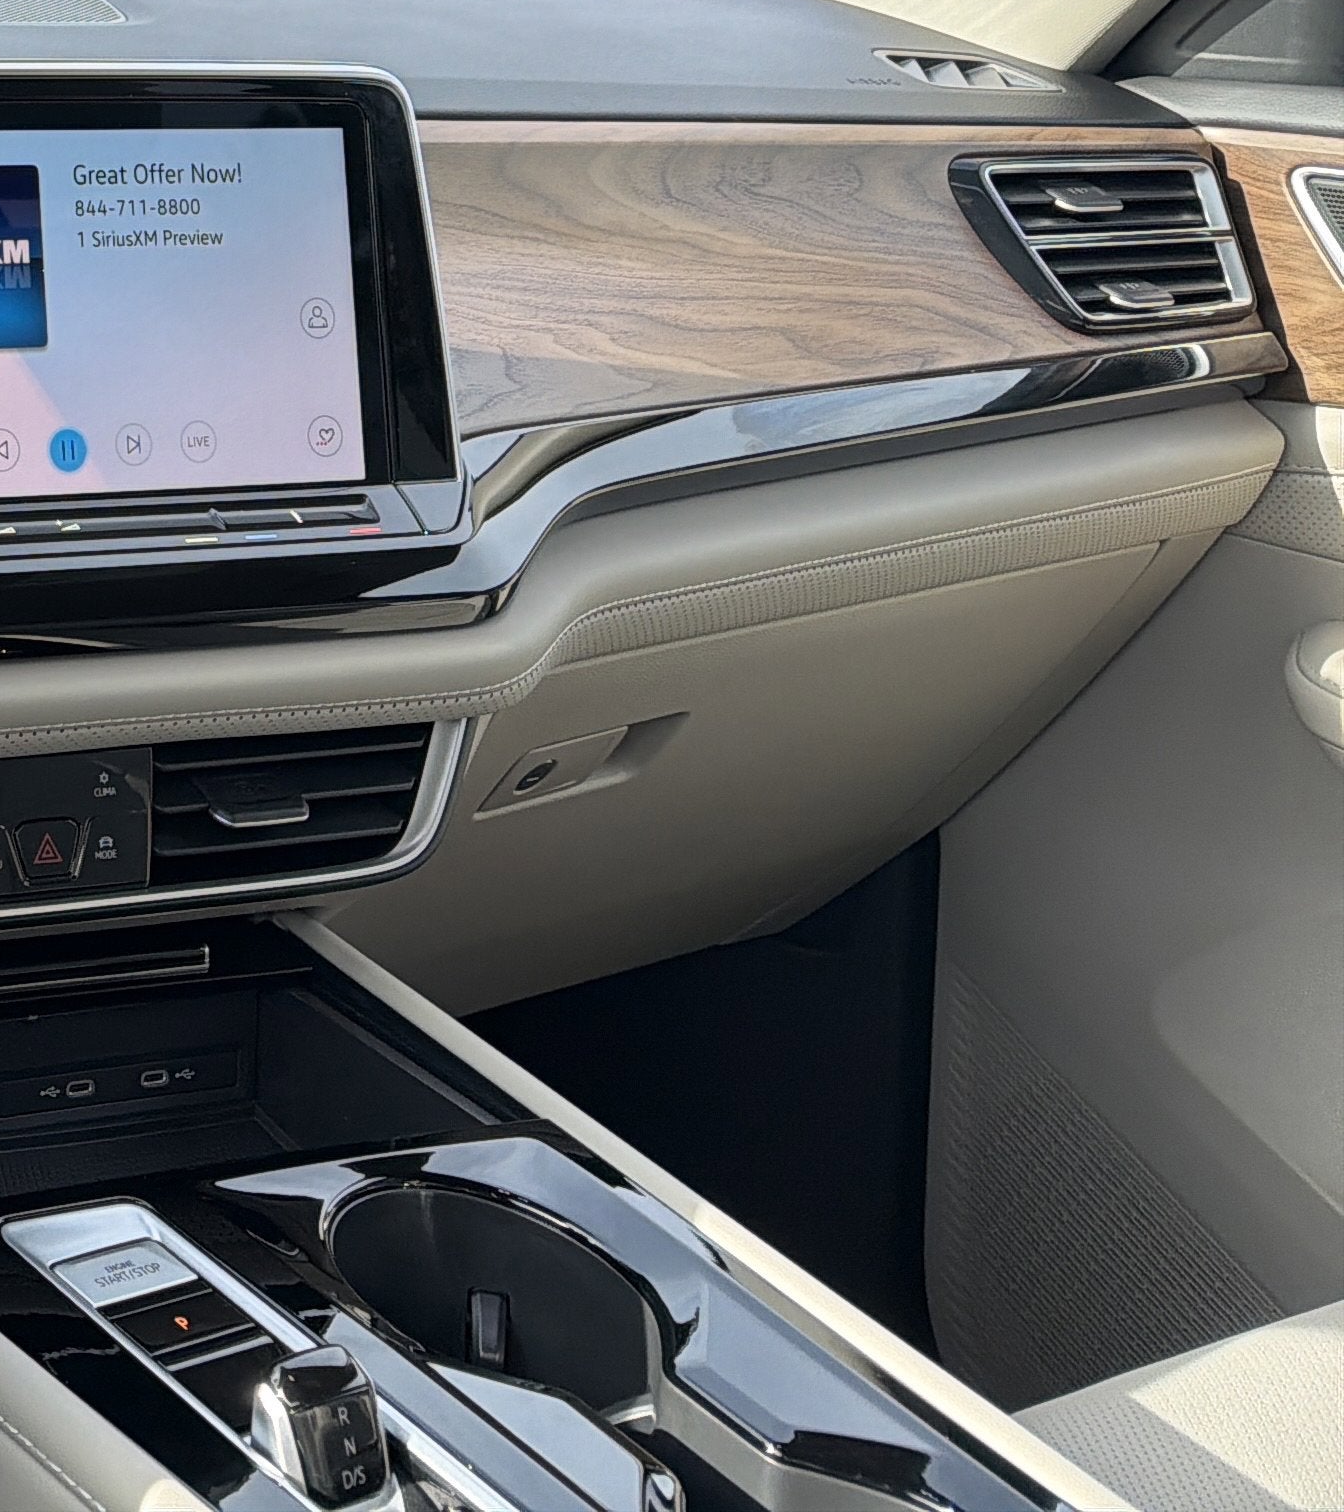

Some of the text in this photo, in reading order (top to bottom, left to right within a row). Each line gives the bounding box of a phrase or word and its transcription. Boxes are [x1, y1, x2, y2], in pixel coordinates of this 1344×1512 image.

[72, 162, 243, 186] Great Offer Now!
[74, 198, 201, 217] 844-711-8800
[78, 228, 224, 248] 1 SiriusXM Preview
[187, 435, 210, 448] LIVE
[93, 787, 116, 798] CLIMA
[95, 849, 118, 860] MODE
[94, 1262, 161, 1288] START/STOP
[104, 1259, 135, 1274] ENGINE
[174, 1316, 189, 1331] P
[336, 1406, 351, 1426] R
[343, 1436, 357, 1457] N
[341, 1464, 367, 1490] D/S
